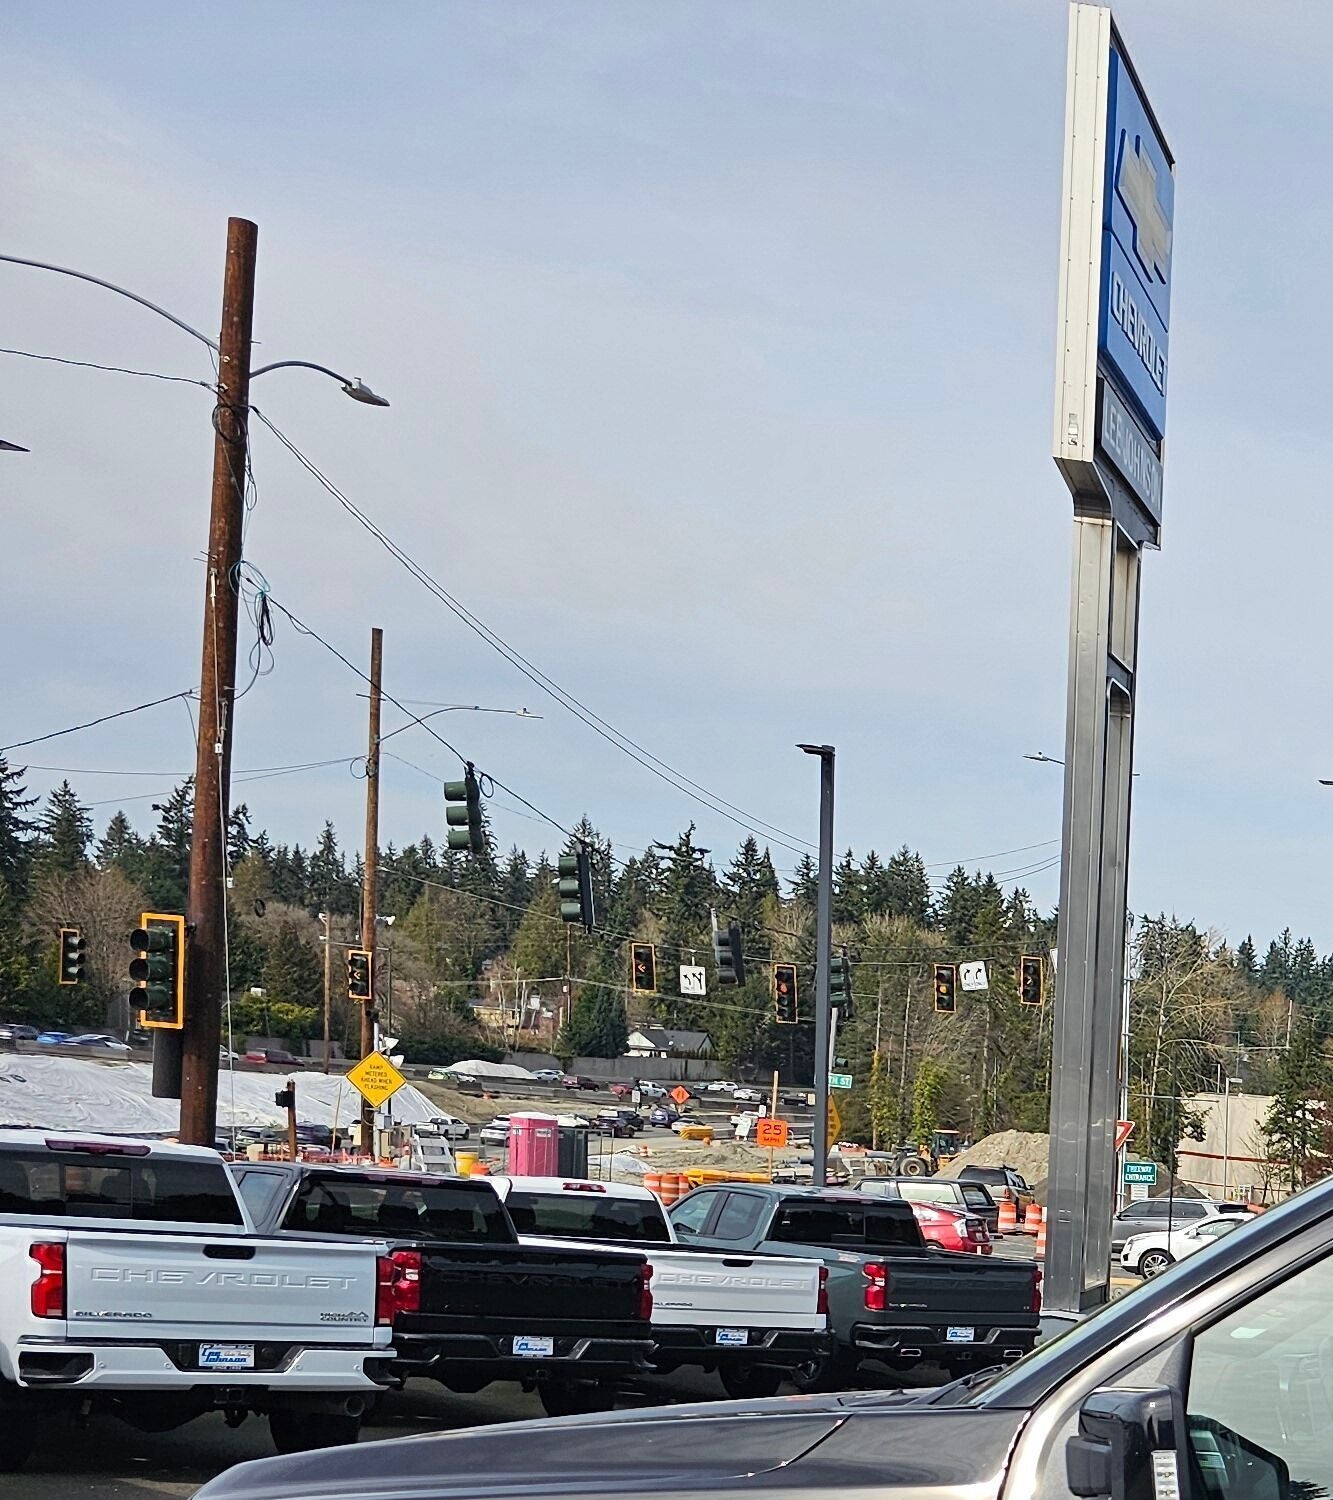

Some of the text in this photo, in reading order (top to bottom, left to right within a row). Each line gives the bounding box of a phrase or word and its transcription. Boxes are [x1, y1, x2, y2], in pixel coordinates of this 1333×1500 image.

[1111, 271, 1167, 397] CHEVROLET
[1103, 398, 1162, 511] LEE JOHNSON
[840, 1077, 850, 1086] ST
[763, 1123, 782, 1135] 25
[91, 1268, 357, 1290] CHEVROLET
[658, 1273, 809, 1289] CHEVROLET
